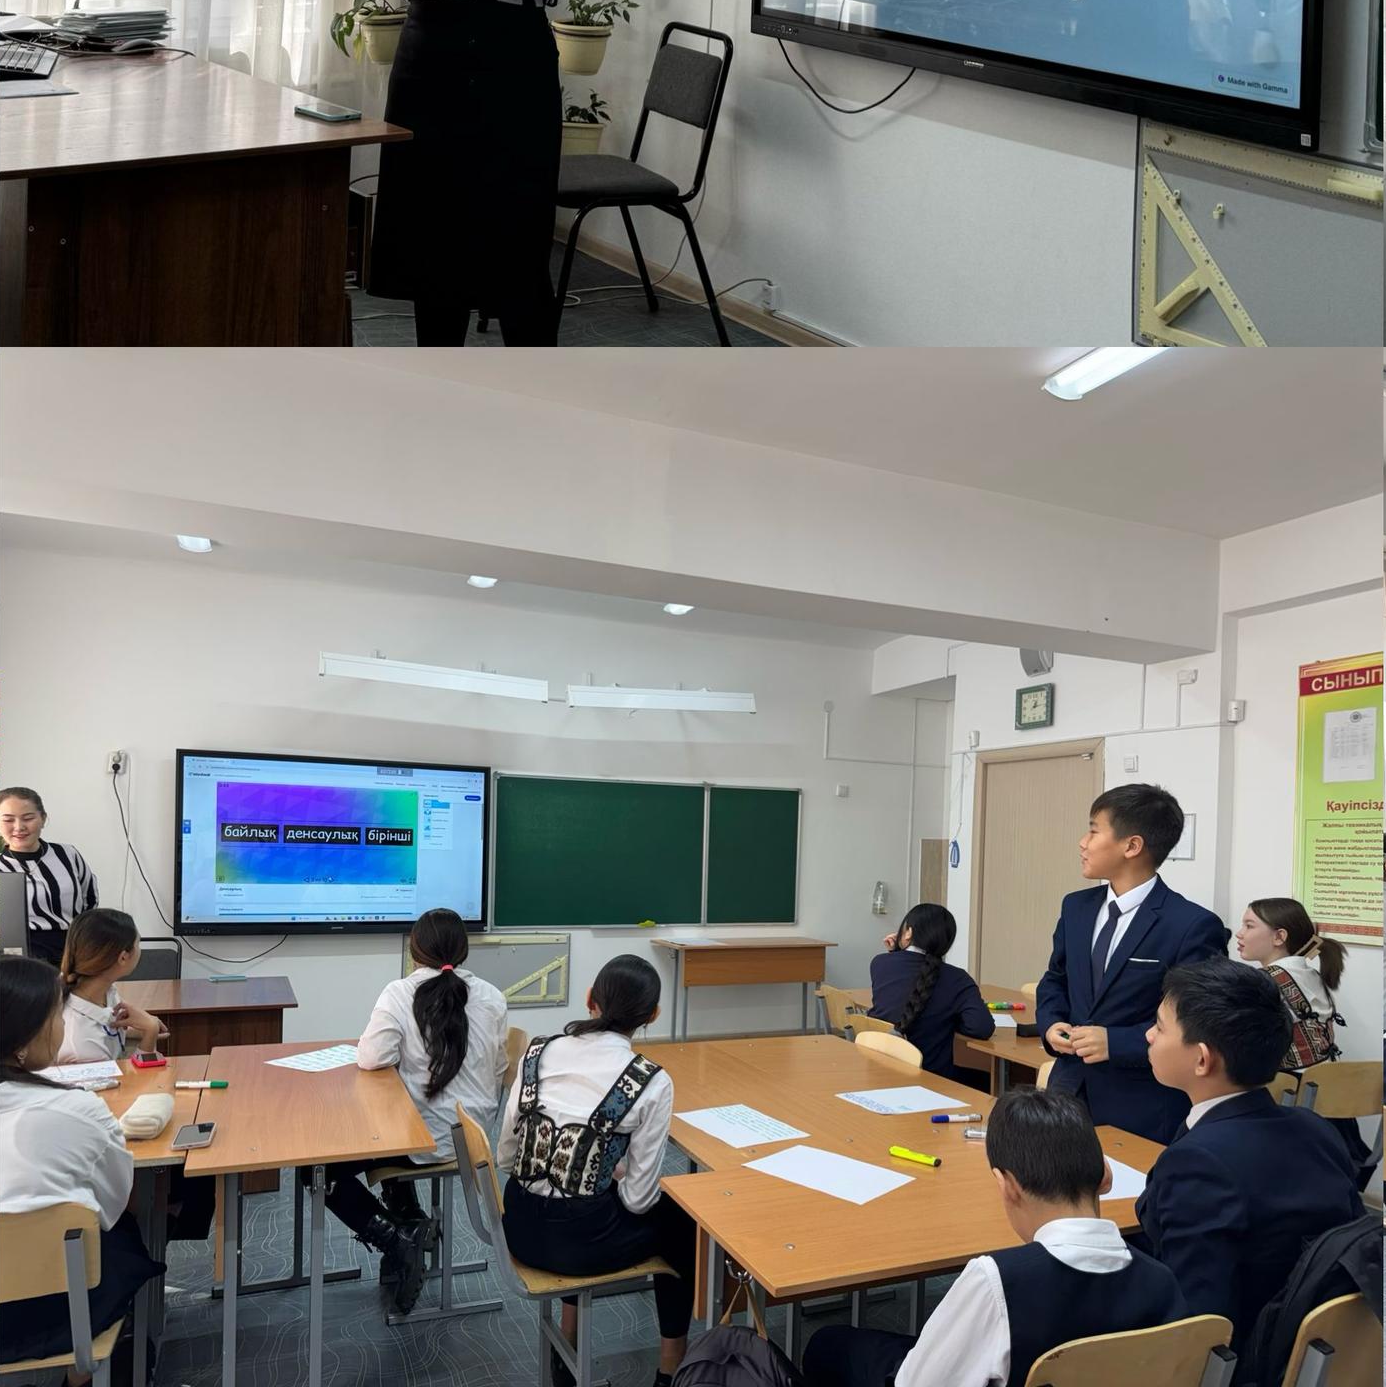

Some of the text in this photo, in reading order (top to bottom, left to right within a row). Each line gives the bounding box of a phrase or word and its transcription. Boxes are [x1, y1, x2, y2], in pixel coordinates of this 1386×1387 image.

[1227, 77, 1245, 86] Made
[1263, 83, 1288, 94] Gamma
[1311, 668, 1383, 692] СЫНЫП
[224, 825, 411, 843] байлық денсаулық бірінші
